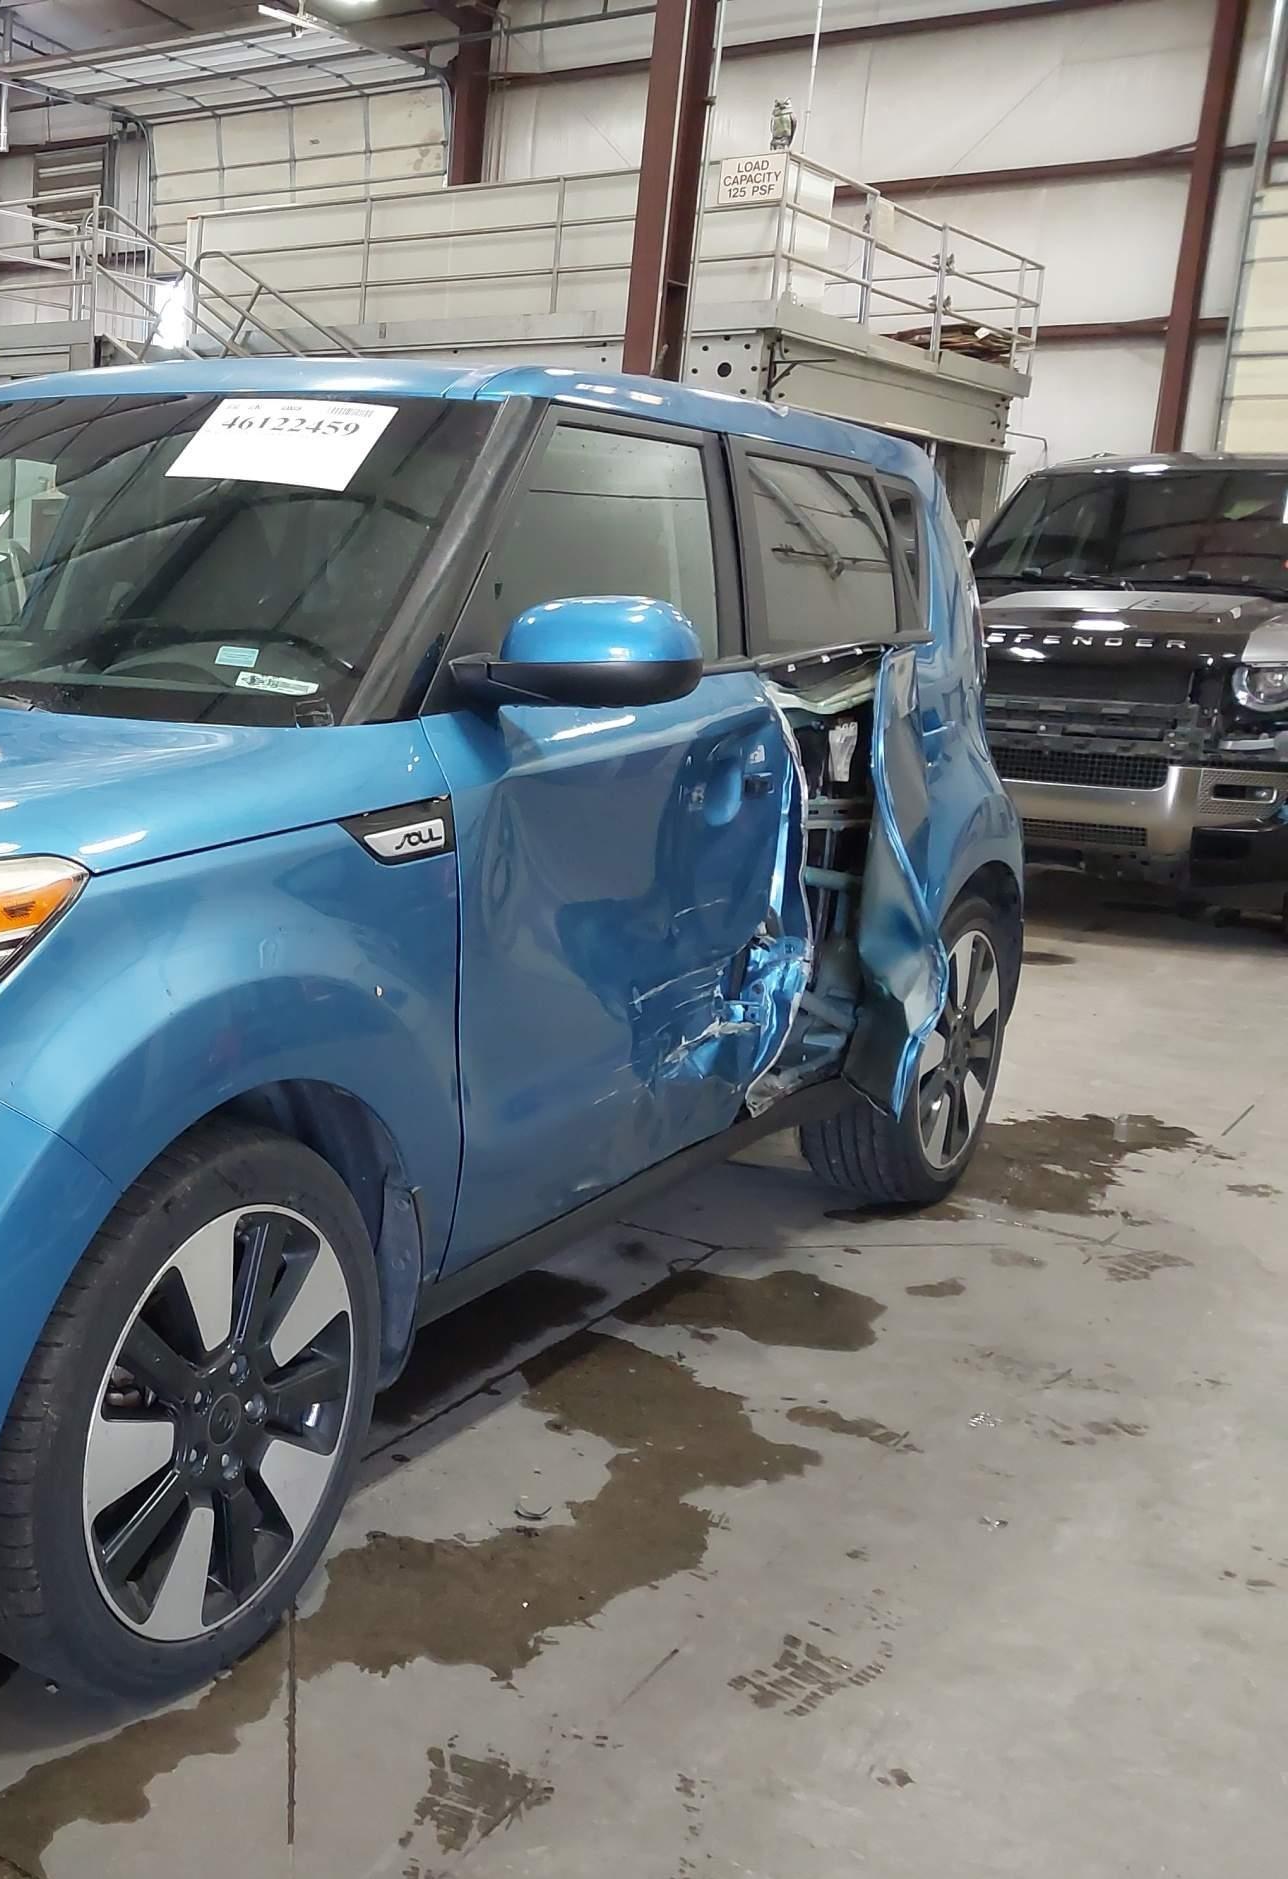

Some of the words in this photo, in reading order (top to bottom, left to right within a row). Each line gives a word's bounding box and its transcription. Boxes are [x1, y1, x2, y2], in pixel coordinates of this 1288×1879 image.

[737, 160, 770, 173] LOAD
[723, 171, 782, 187] CAPACITY
[728, 187, 746, 199] 125
[752, 184, 775, 196] PSF
[220, 415, 360, 436] 46122459
[982, 632, 1187, 649] EFENDER
[395, 828, 443, 850] SOUL
